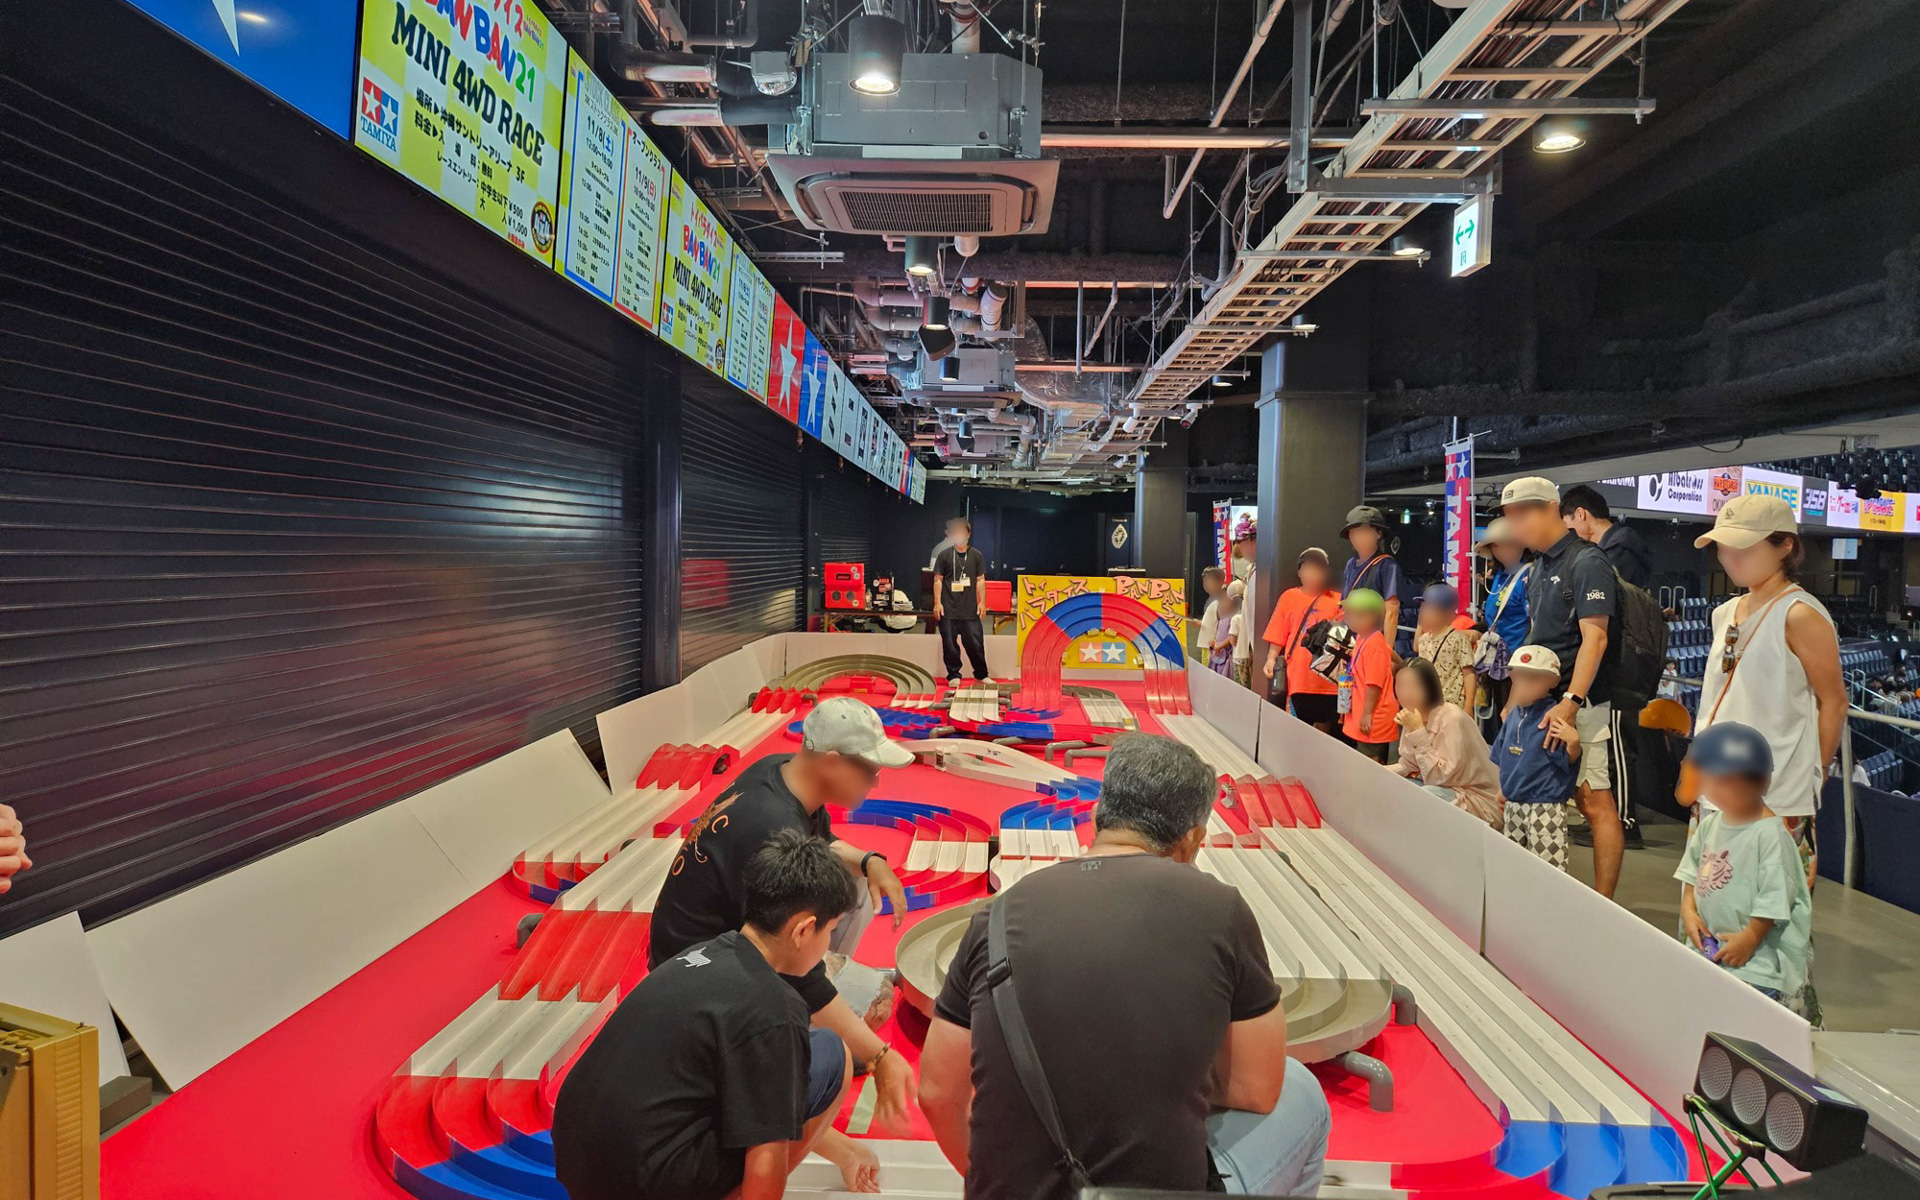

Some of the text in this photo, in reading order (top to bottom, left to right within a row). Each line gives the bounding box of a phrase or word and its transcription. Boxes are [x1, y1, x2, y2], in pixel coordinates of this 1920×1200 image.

[425, 0, 536, 103] ANBAN21
[391, 2, 545, 166] MINI 4WD RACE
[361, 115, 397, 153] TAMIYA
[414, 110, 432, 137] 料金
[672, 256, 691, 292] MINI
[690, 273, 706, 305] 4WD
[705, 287, 723, 319] RACE
[1667, 471, 1704, 490] Albatross
[1667, 488, 1703, 502] Corporation
[1803, 488, 1828, 510] 358
[1586, 591, 1605, 601] 1982
